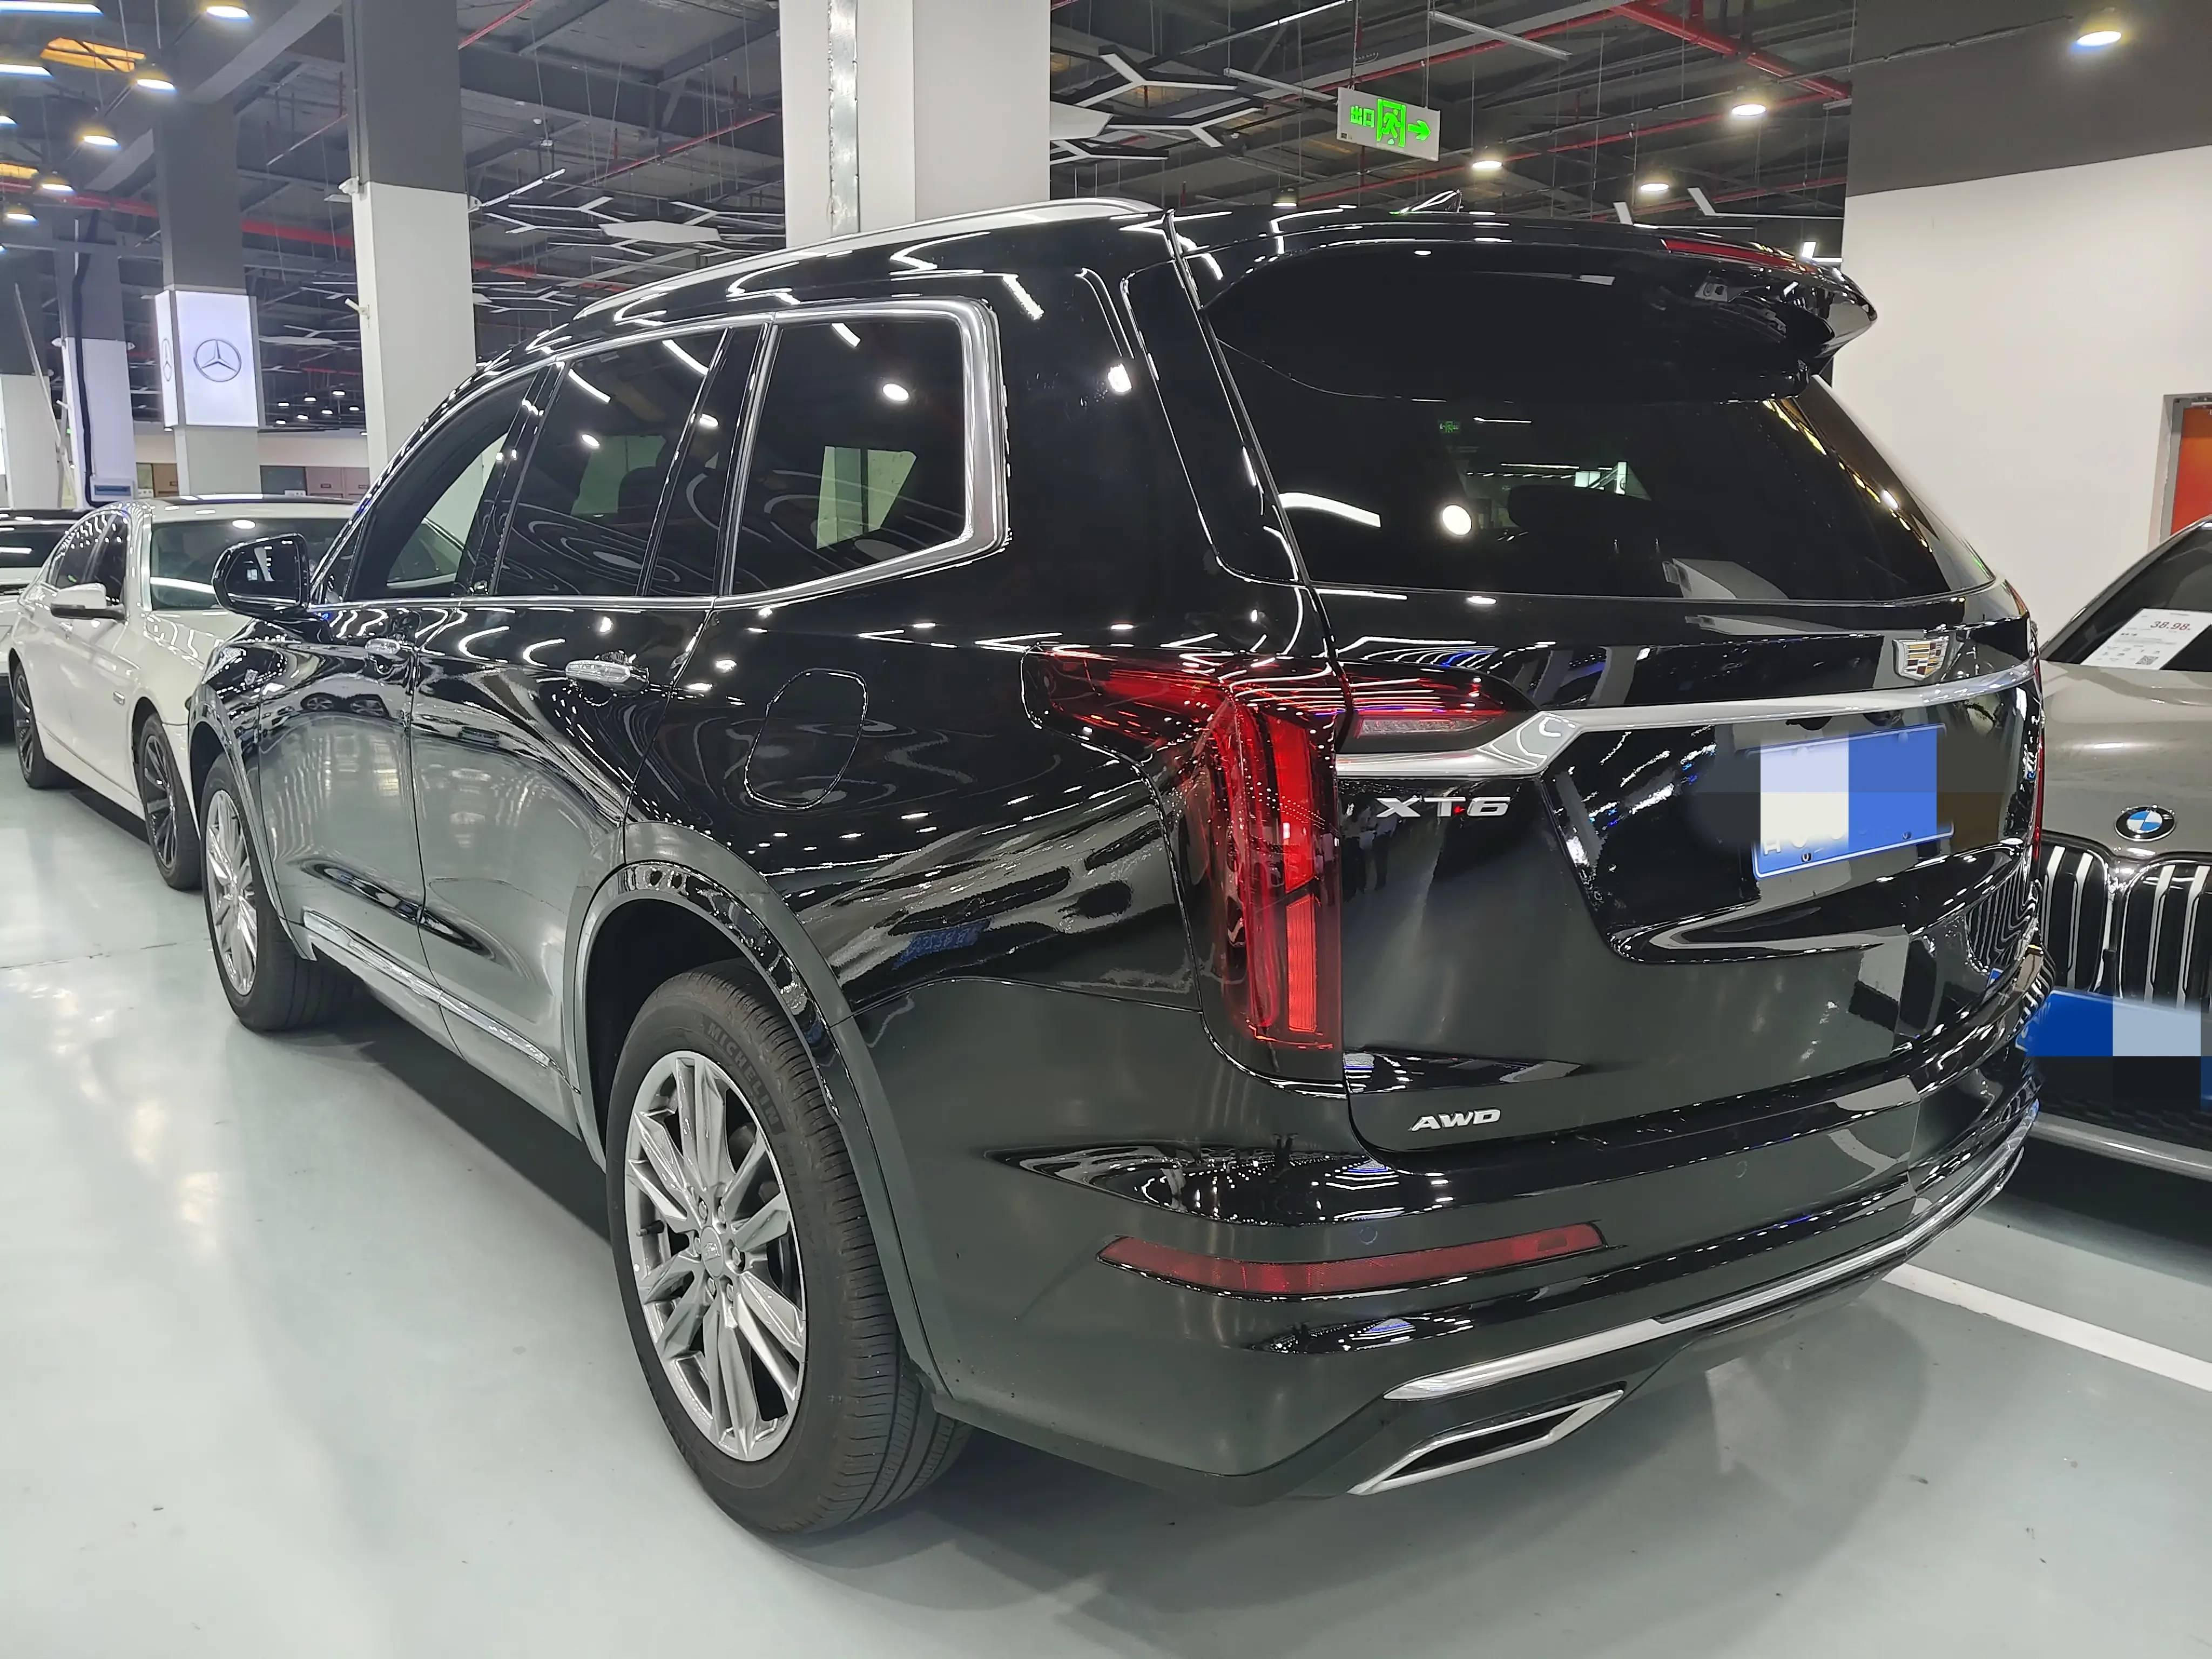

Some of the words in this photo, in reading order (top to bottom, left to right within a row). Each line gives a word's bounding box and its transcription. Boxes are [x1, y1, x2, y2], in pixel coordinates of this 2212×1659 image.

[1350, 105, 1375, 127] 出口
[1376, 796, 1511, 817] XT6
[707, 1022, 779, 1125] MICHELIN
[1410, 1108, 1501, 1131] AWD
